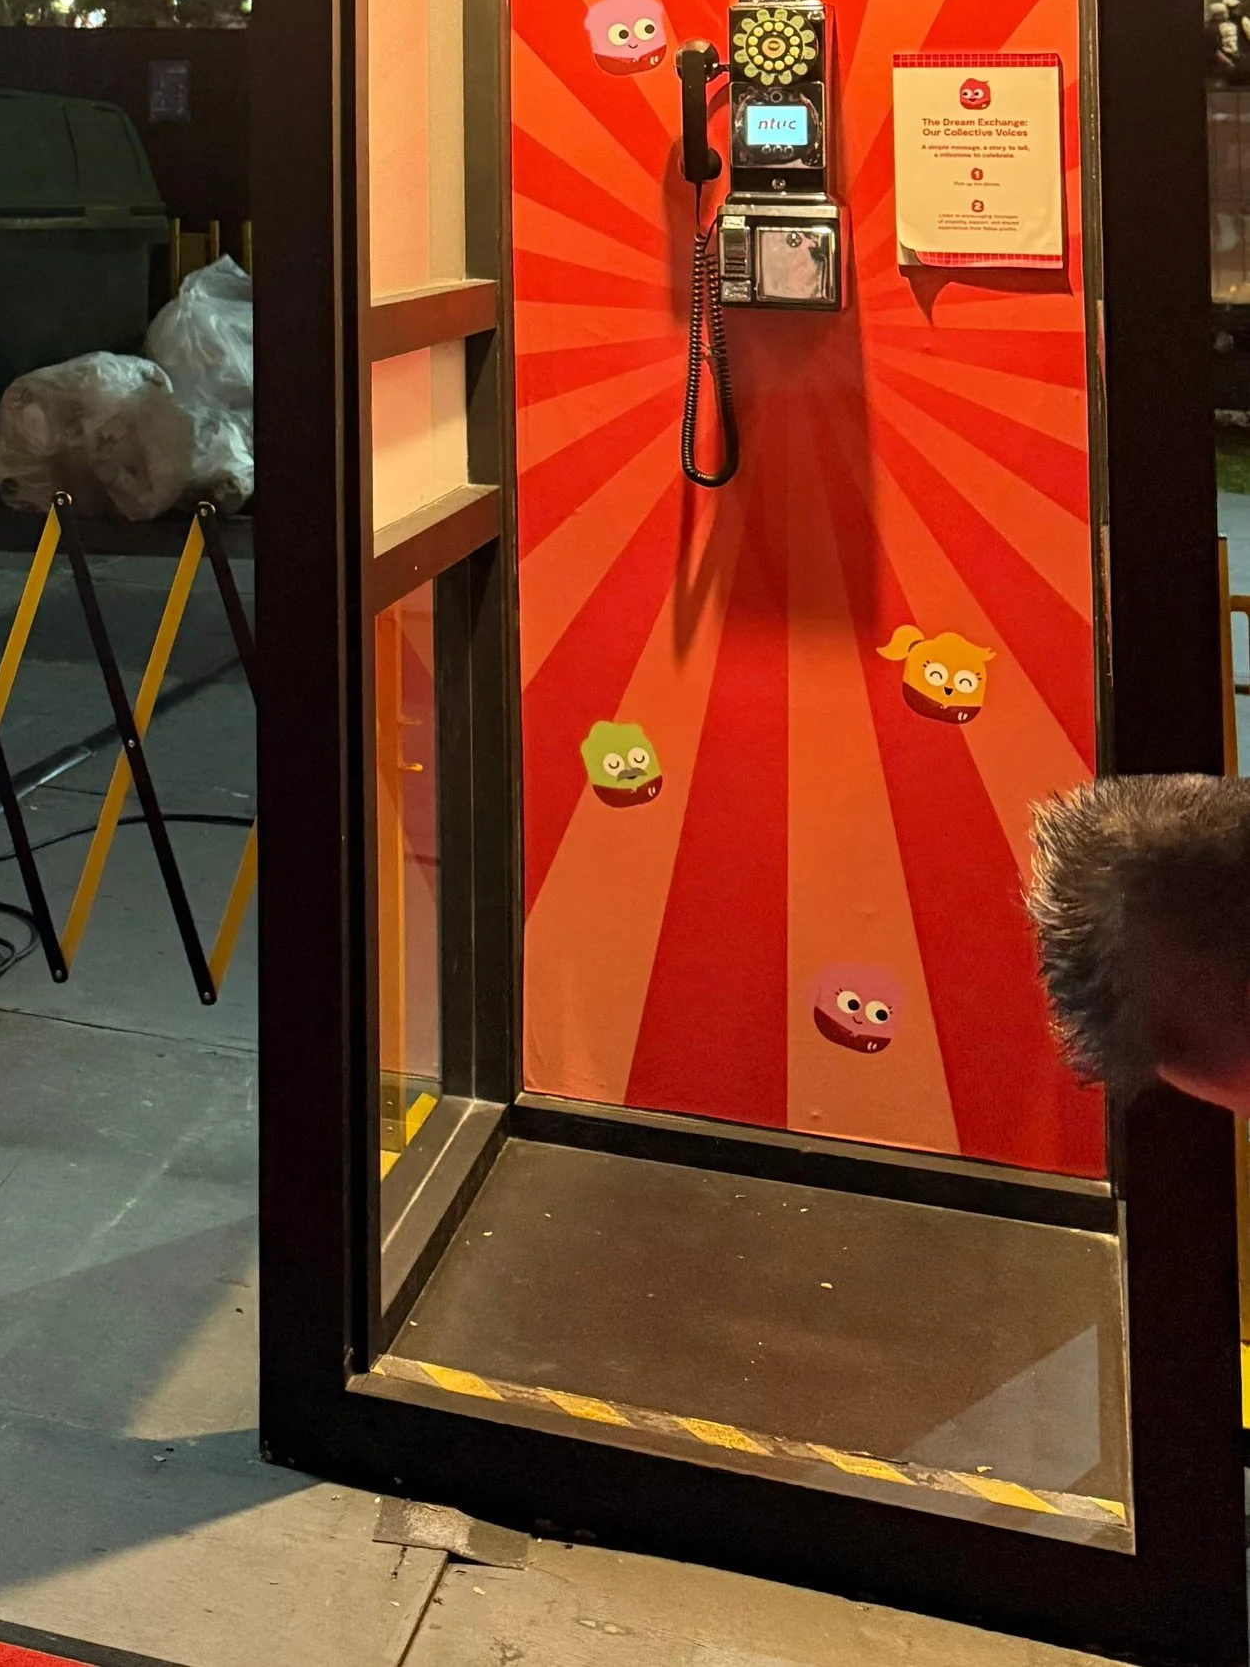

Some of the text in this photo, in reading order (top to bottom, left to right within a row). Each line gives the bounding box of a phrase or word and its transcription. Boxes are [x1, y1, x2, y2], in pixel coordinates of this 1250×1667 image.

[922, 118, 1028, 128] The Dream Exchange:
[922, 128, 1028, 137] Our Collective Voices
